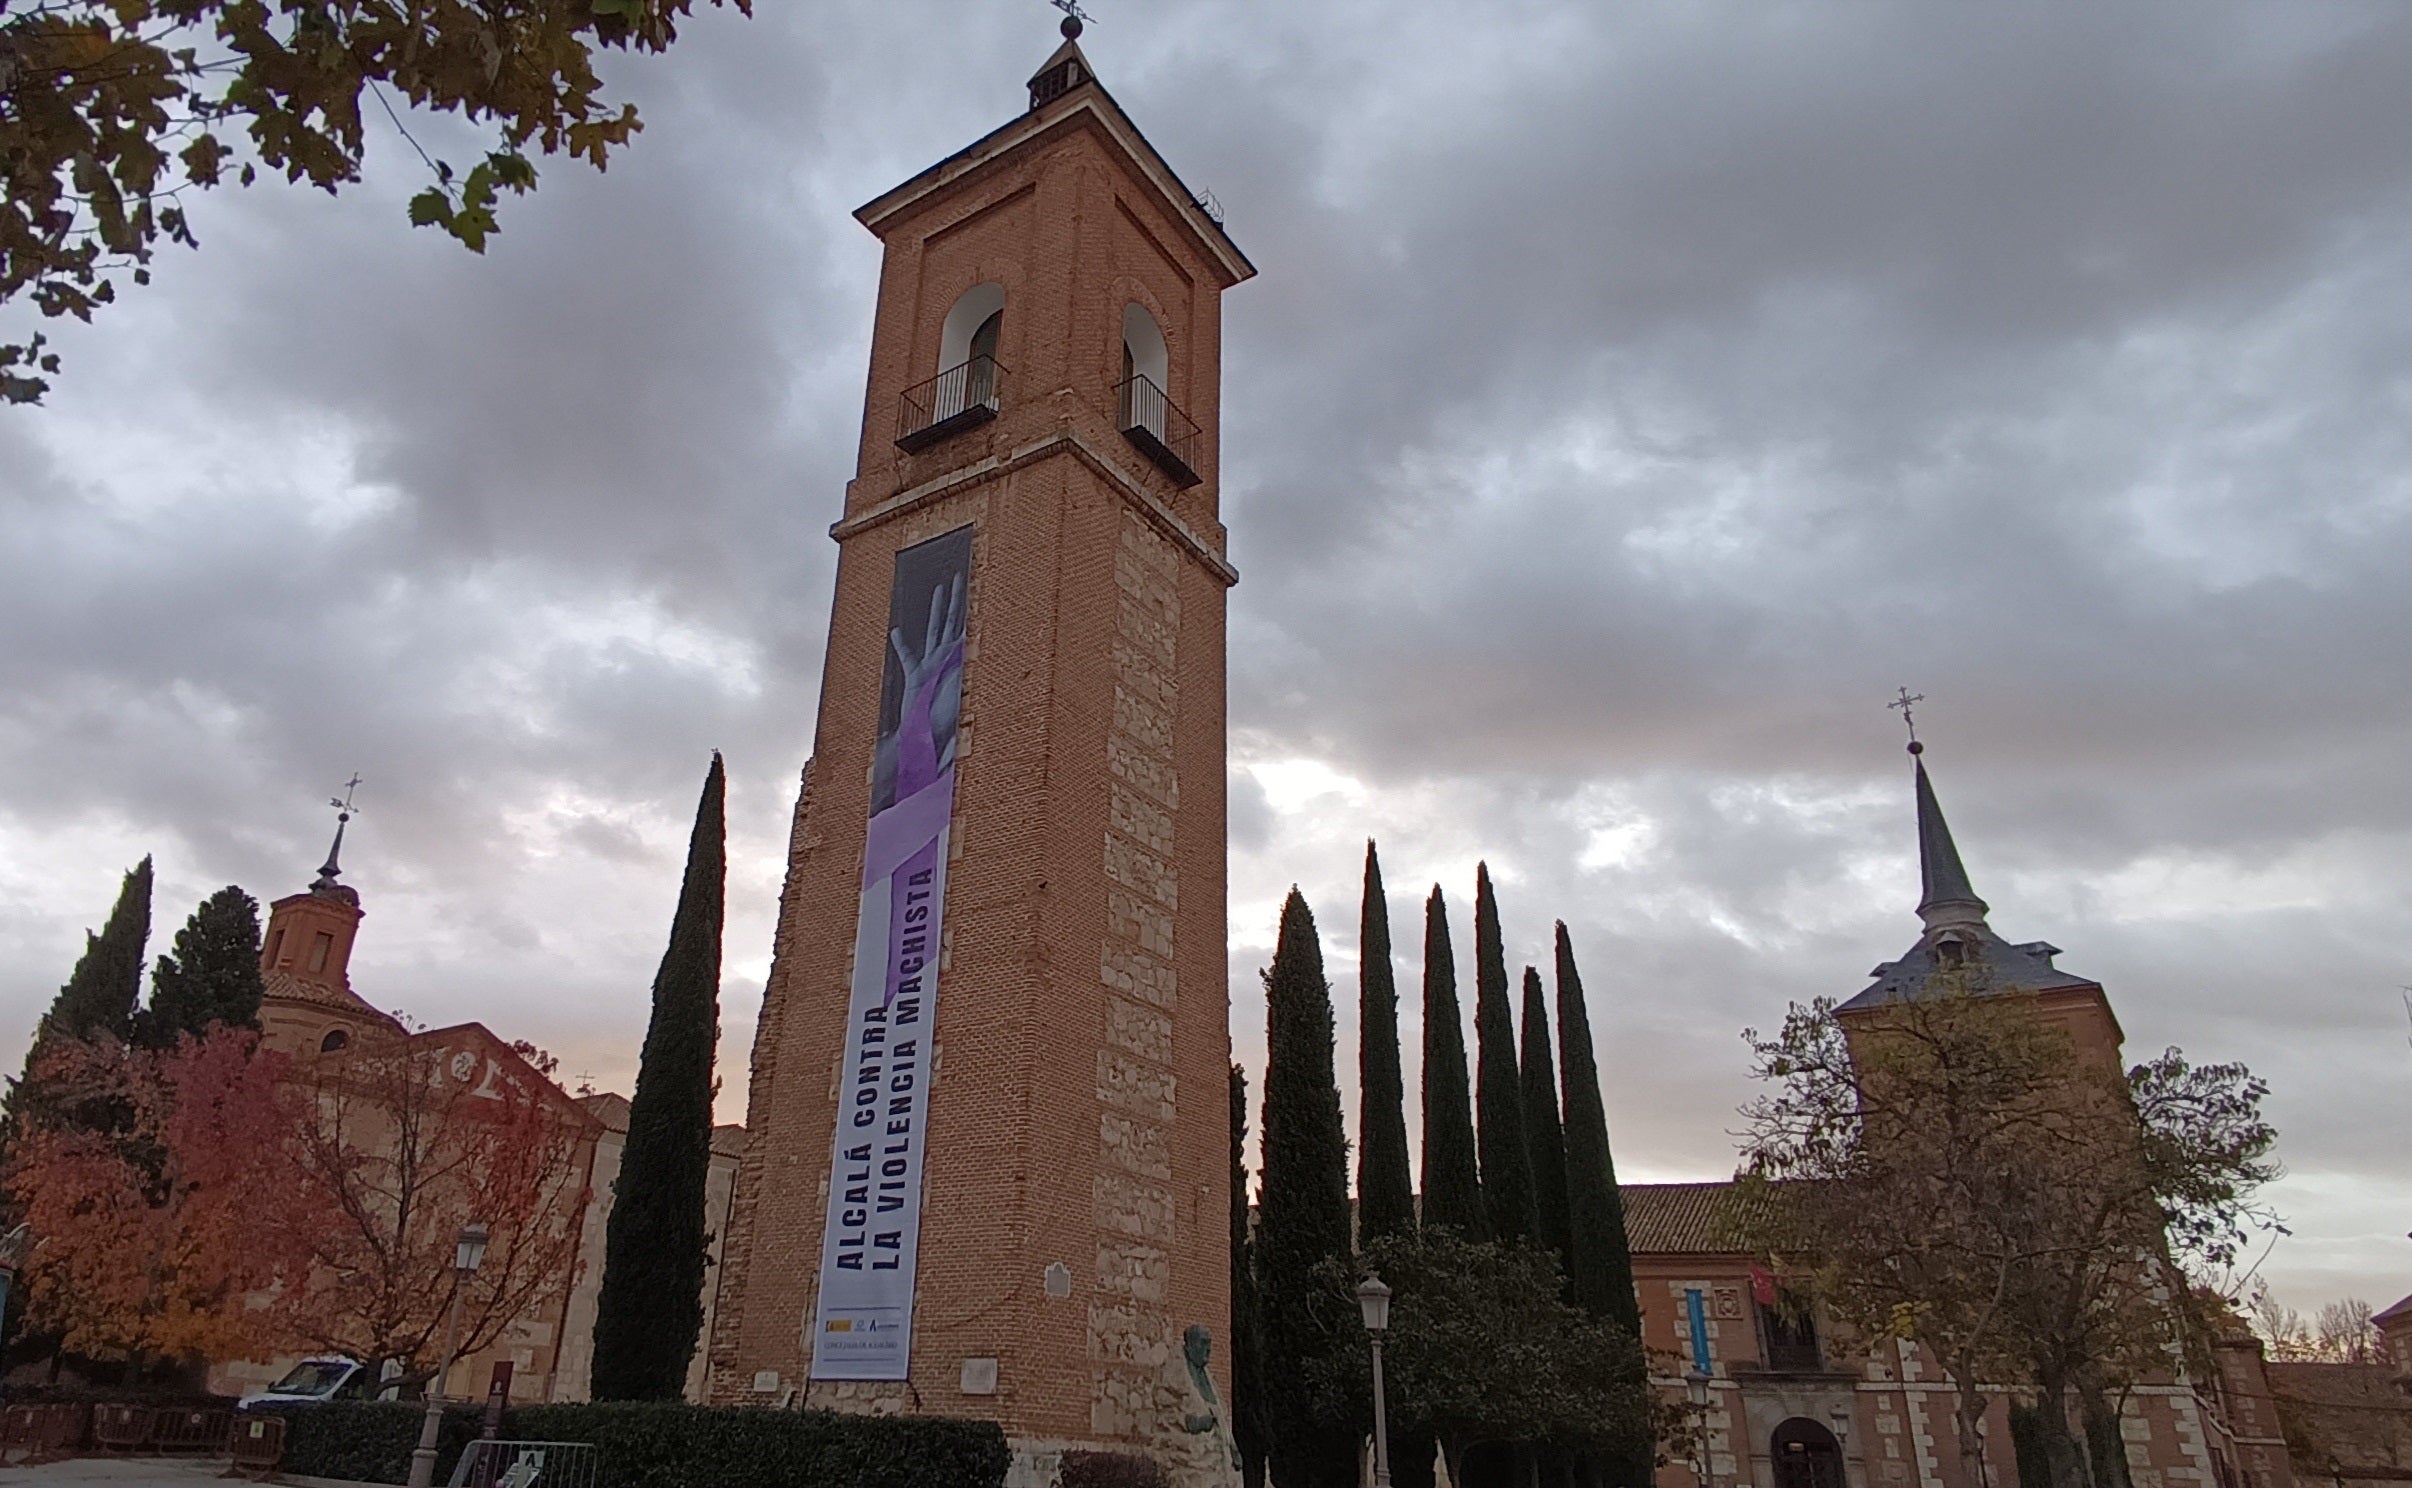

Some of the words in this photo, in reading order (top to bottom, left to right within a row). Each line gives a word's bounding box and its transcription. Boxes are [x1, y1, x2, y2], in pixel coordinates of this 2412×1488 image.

[895, 868, 933, 1026] MACHISTA
[853, 1006, 889, 1128] CONTRA
[876, 1039, 917, 1213] VIOLENCIA
[836, 1143, 872, 1270] ALCALÁ
[872, 1231, 902, 1270] LA
